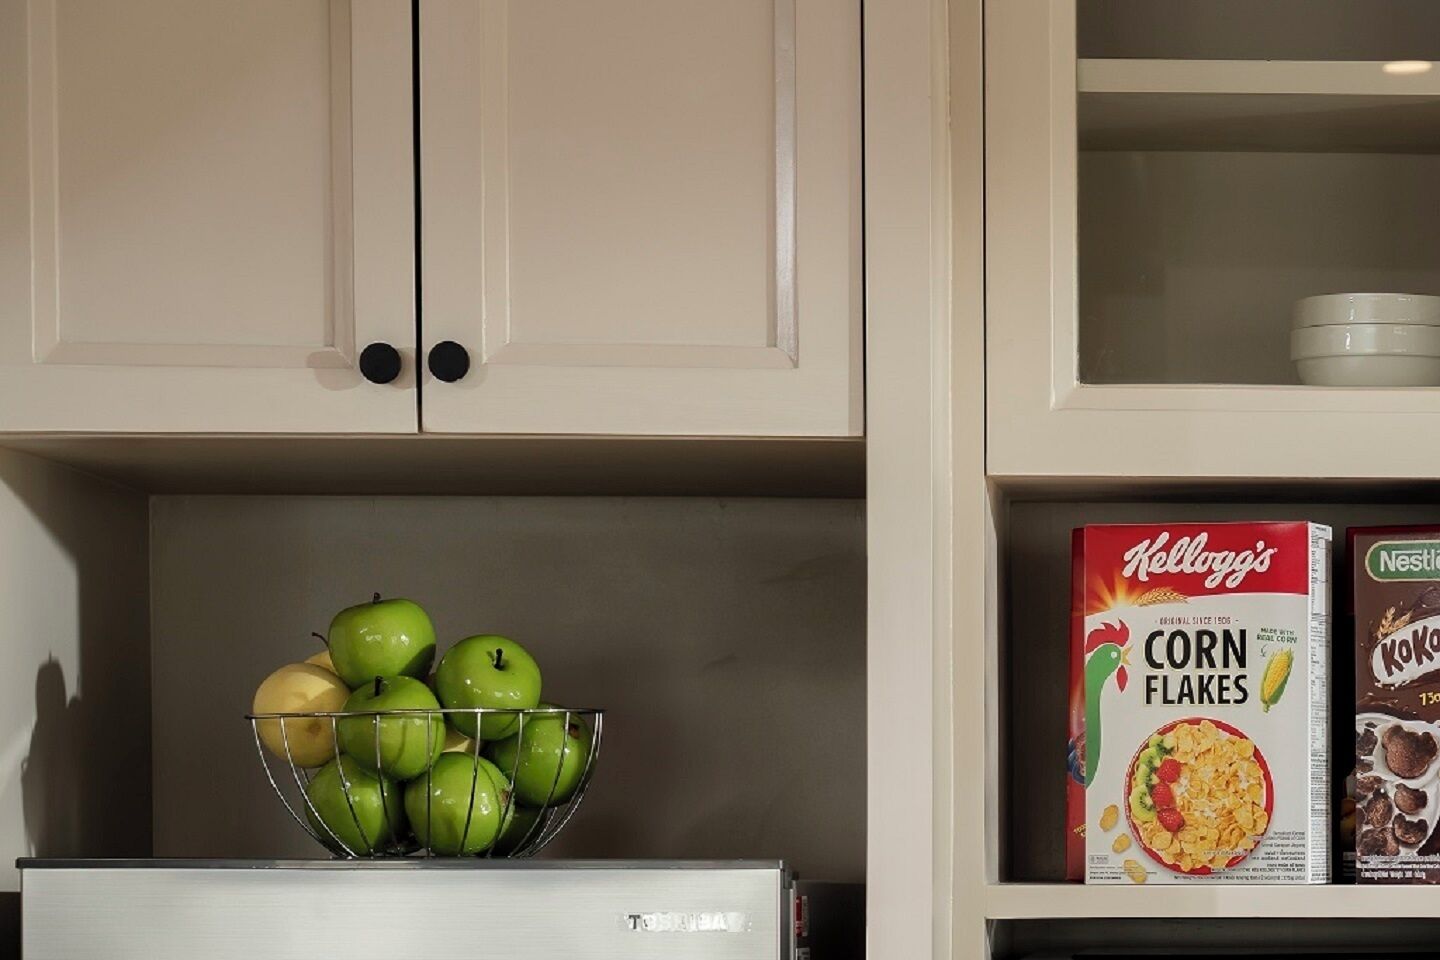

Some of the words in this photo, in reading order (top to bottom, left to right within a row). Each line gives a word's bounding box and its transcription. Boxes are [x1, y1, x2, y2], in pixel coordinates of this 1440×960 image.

[1122, 531, 1275, 588] Kellogg's
[1192, 616, 1212, 625] SINCE
[1144, 629, 1247, 670] CORN
[1145, 674, 1248, 705] FLAKES
